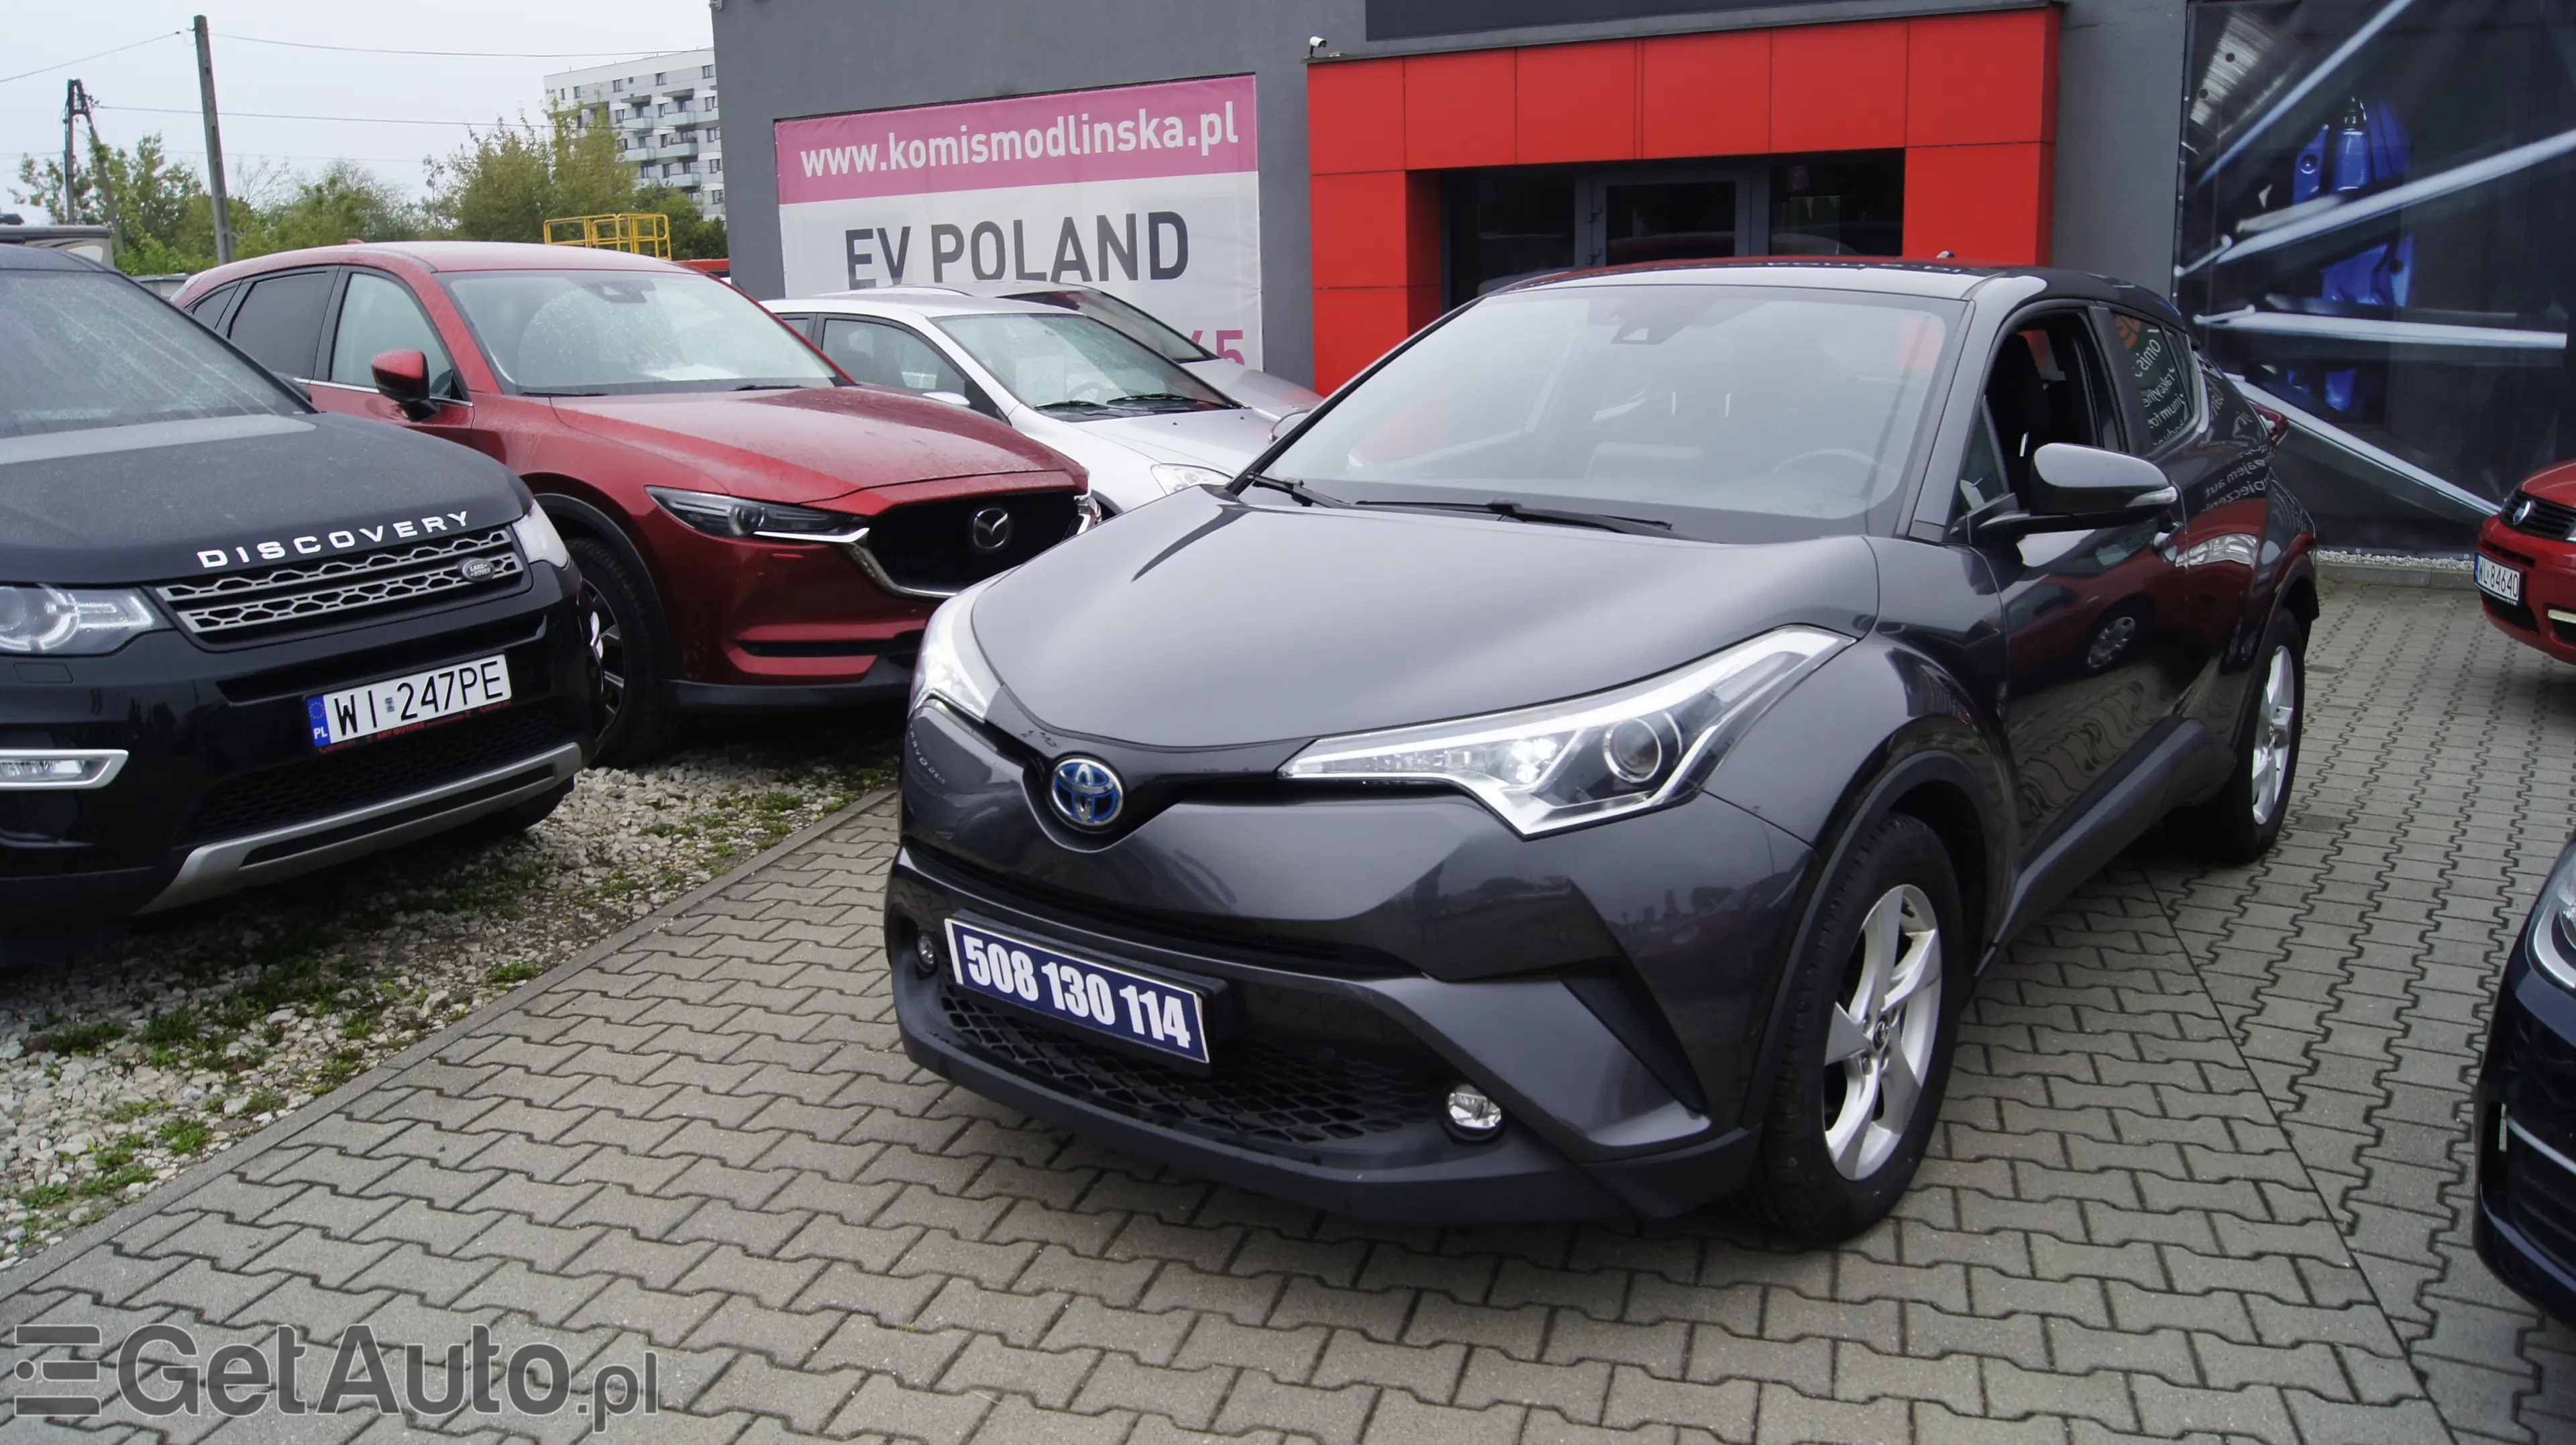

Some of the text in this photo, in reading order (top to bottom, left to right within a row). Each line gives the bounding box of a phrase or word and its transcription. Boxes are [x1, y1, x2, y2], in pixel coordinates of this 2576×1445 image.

[801, 101, 1239, 178] www.komismodlinska.pl
[845, 211, 1189, 290] EV POLAND
[197, 511, 468, 568] DISCOVERY
[2490, 566, 2519, 598] 84640
[313, 727, 328, 739] PL
[333, 661, 503, 737] WI 247PE
[963, 934, 1191, 1049] 508 130 114
